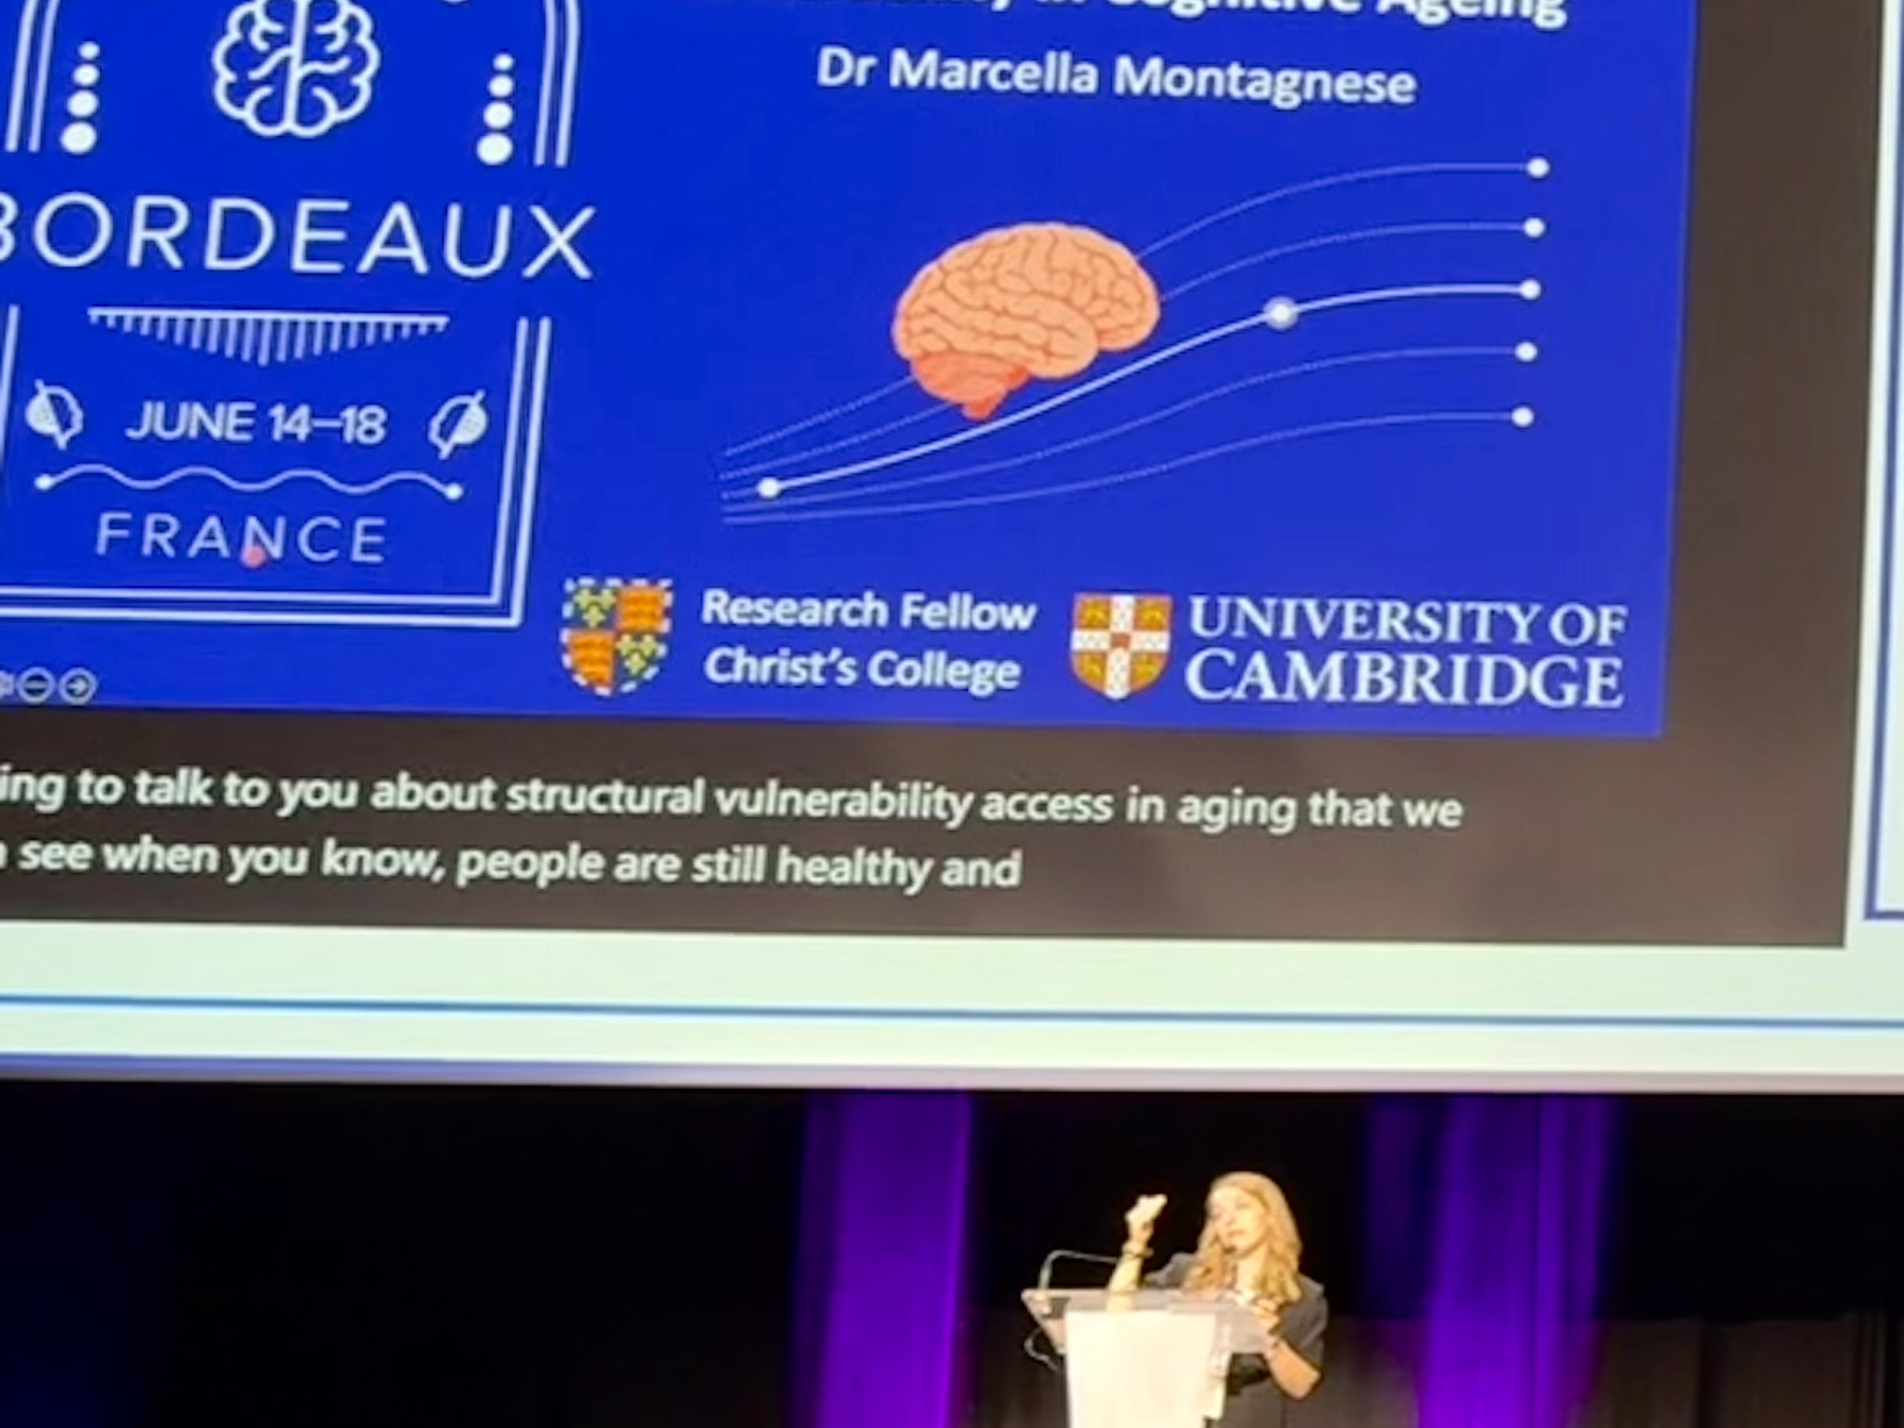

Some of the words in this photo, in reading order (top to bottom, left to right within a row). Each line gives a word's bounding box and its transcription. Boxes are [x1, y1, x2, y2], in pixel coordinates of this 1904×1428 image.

[818, 46, 877, 86] Dr
[890, 48, 1098, 93] Marcella
[1114, 56, 1416, 110] Montagnese
[127, 402, 254, 440] JUNE
[97, 512, 385, 564] FRANCE
[702, 588, 889, 627] Research
[900, 592, 1037, 630] Fellow
[1190, 596, 1542, 644] UNIVERSITY
[1549, 604, 1627, 646] OF
[867, 650, 1021, 697] College
[1185, 647, 1624, 708] CAMBRIDGE
[77, 769, 125, 804] to
[134, 767, 213, 805] talk
[224, 772, 270, 807] to
[277, 779, 359, 817] you
[370, 771, 498, 811] about
[506, 777, 705, 814] structural
[715, 779, 975, 829] vulnerability
[981, 792, 1113, 822] access
[1127, 785, 1165, 822] in
[1177, 787, 1297, 835] aging
[1308, 788, 1393, 827] that
[1403, 799, 1463, 827] we
[19, 841, 93, 870] see
[102, 834, 220, 873] when
[226, 846, 309, 884] you
[322, 837, 446, 883] know,
[456, 841, 606, 889] people
[613, 852, 682, 882] are
[691, 845, 767, 883] still
[777, 845, 935, 896] healthy
[941, 850, 1023, 887] and
